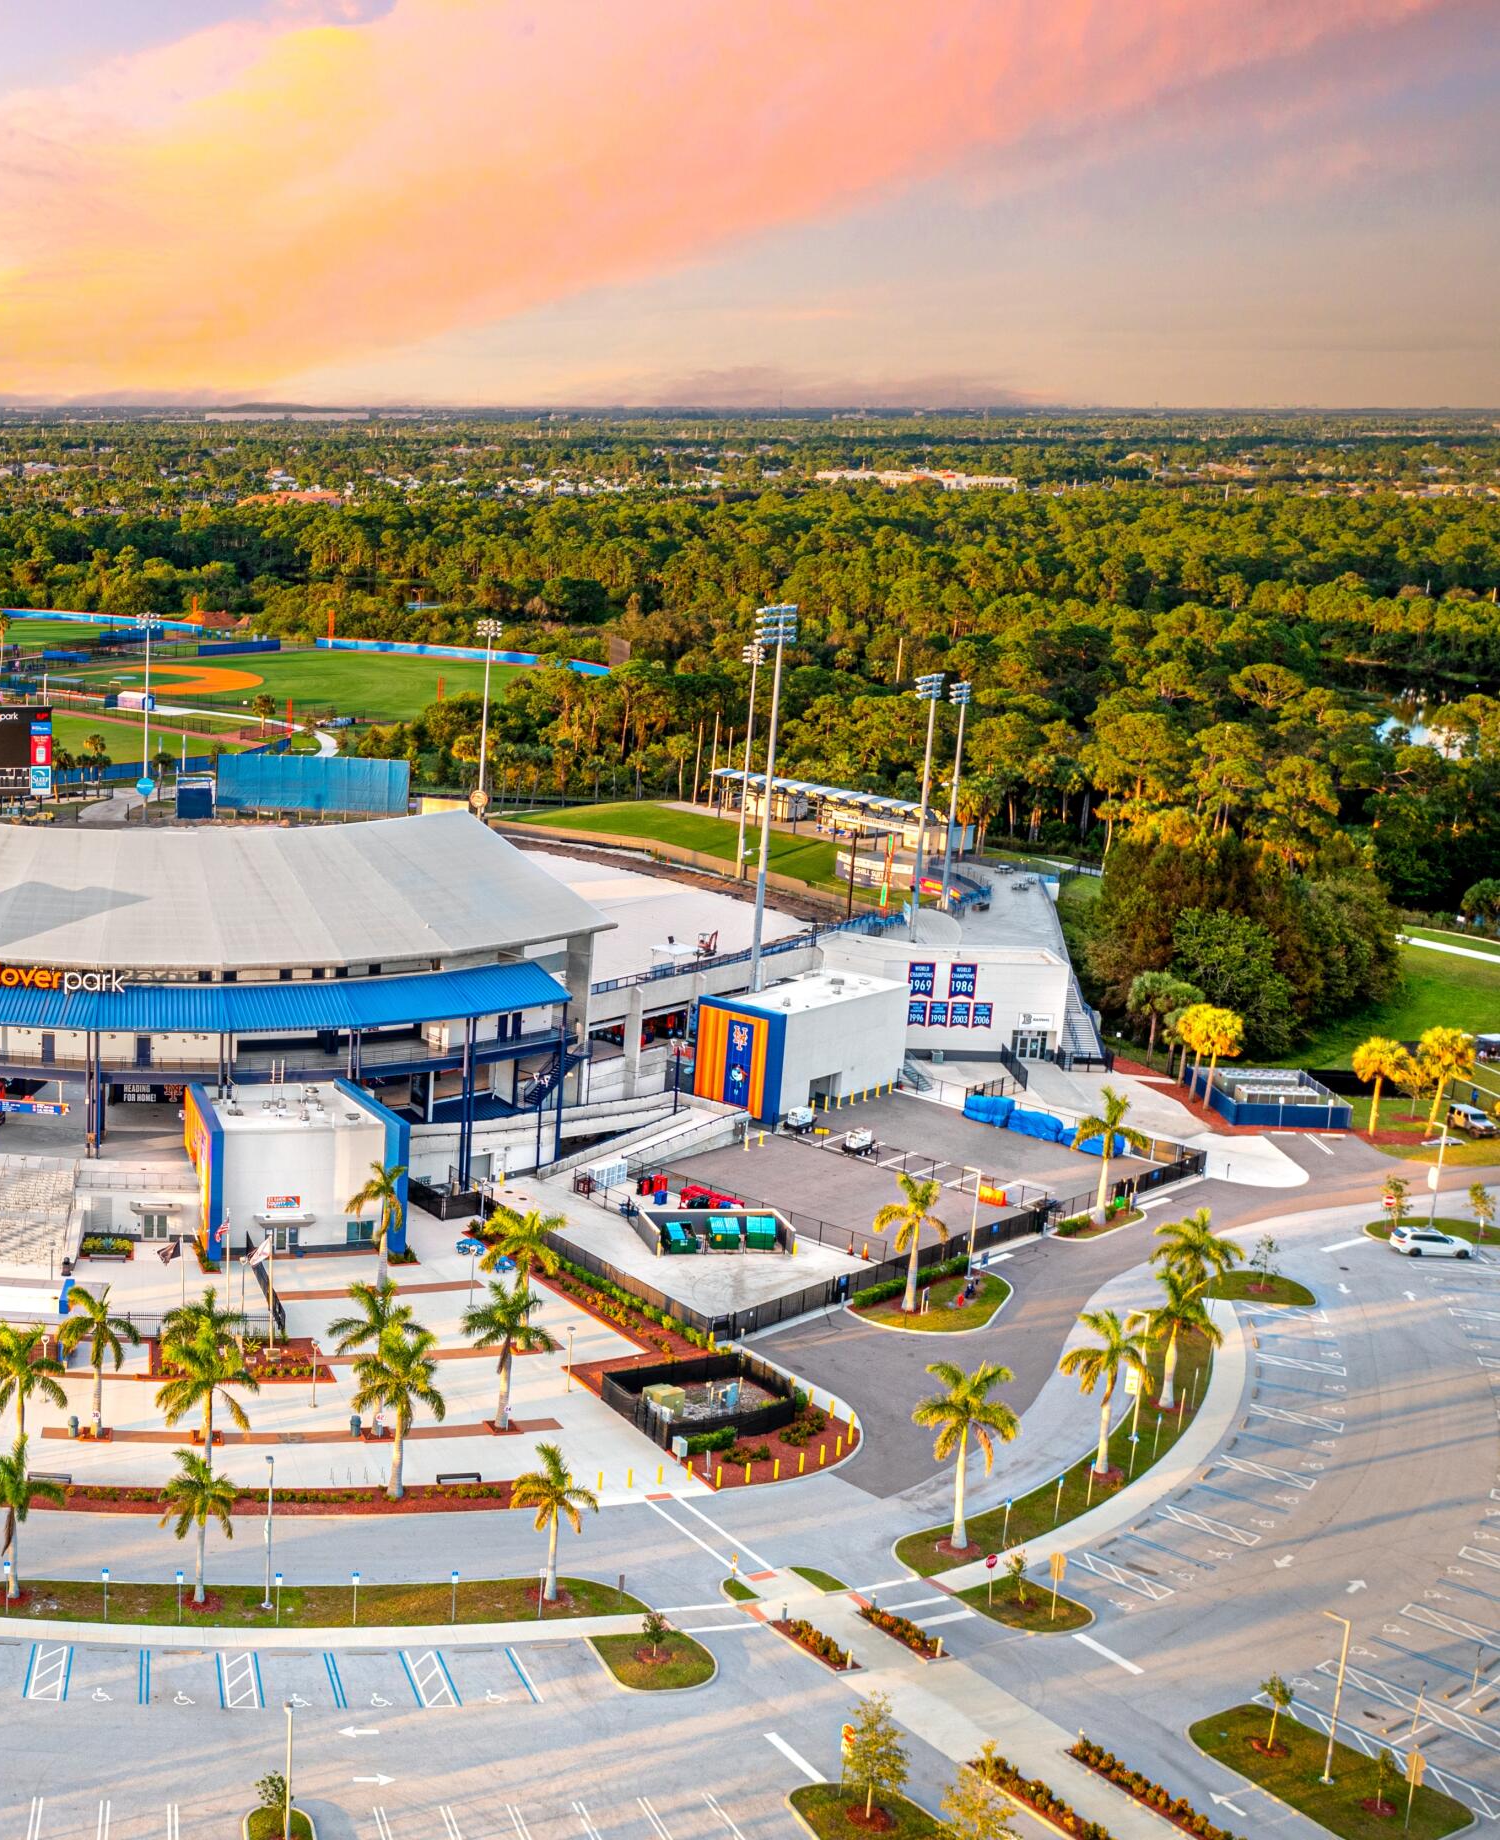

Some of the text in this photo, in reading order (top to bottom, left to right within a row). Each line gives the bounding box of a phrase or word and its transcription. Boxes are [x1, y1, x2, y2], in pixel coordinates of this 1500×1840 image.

[0, 712, 19, 722] park
[63, 968, 125, 994] park
[909, 979, 932, 991] 1969
[951, 980, 974, 992] 1986
[909, 1013, 924, 1022] 1996
[930, 1014, 946, 1023] 1998
[952, 1015, 968, 1024] 2003
[973, 1015, 990, 1024] 2006
[123, 1084, 150, 1093] HEADING
[123, 1094, 157, 1102] FOR HOME!
